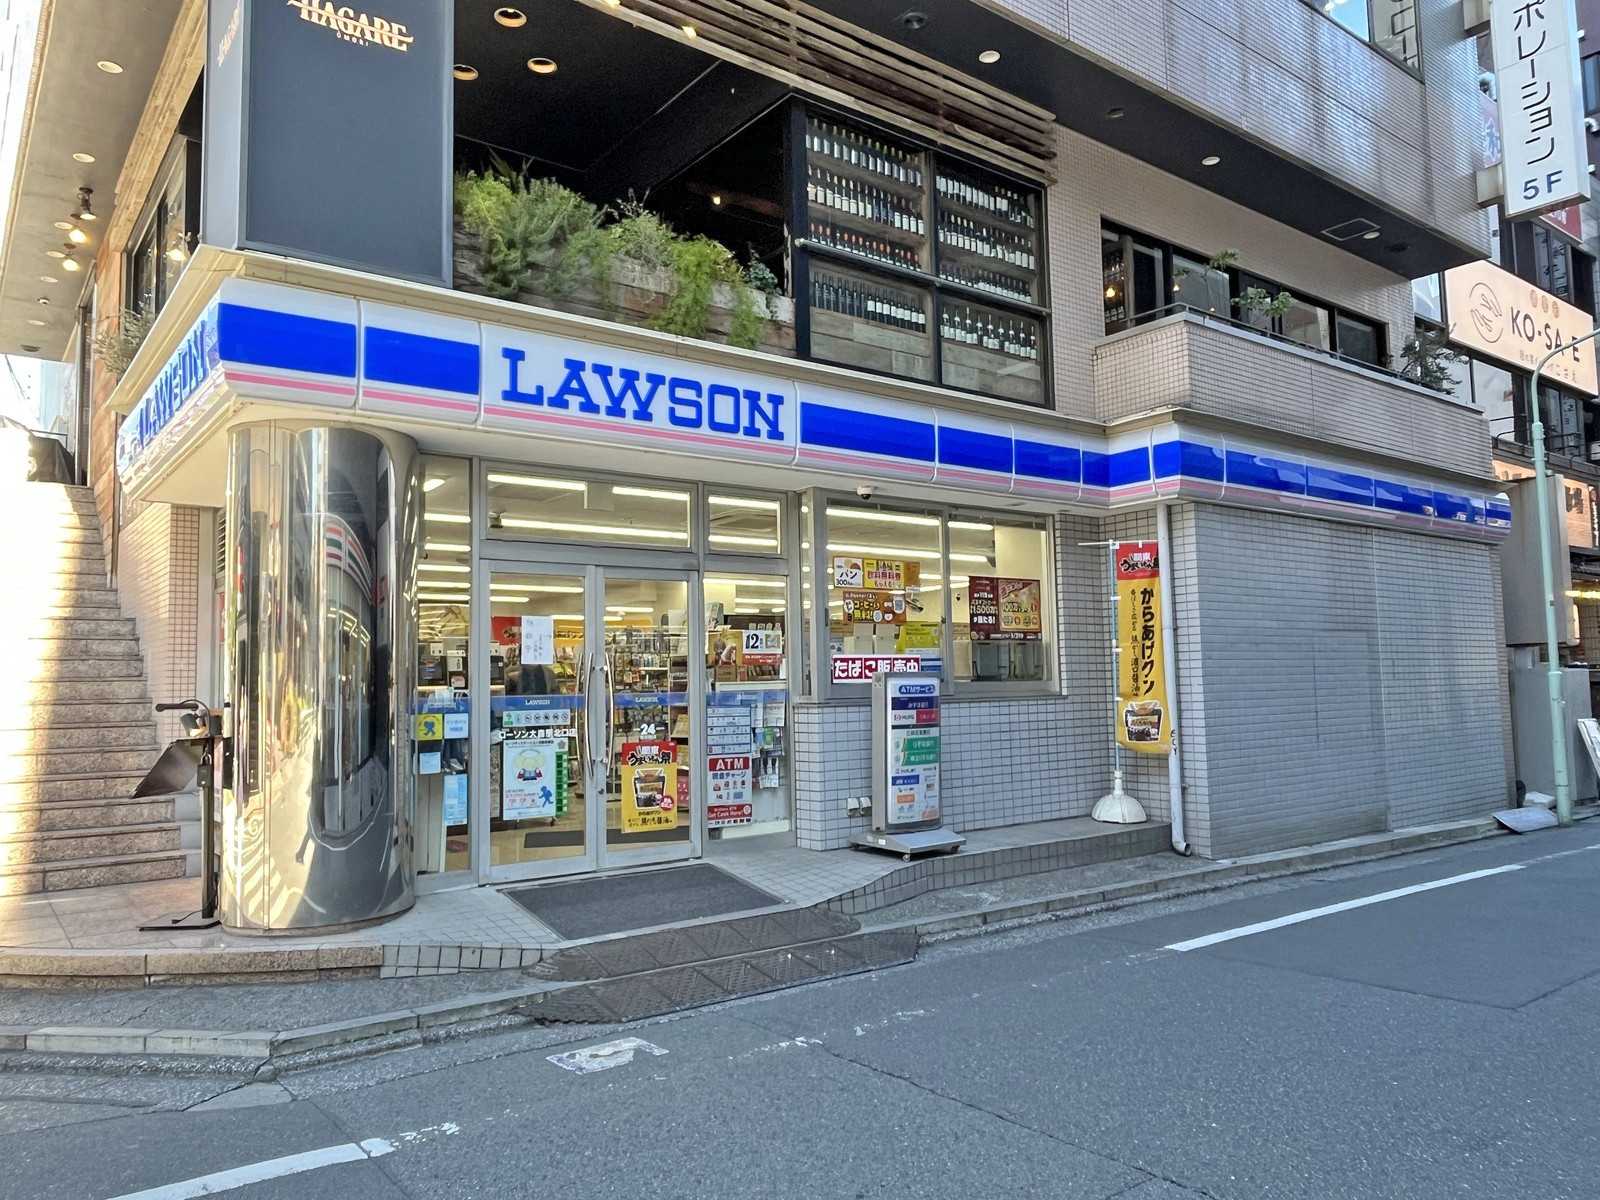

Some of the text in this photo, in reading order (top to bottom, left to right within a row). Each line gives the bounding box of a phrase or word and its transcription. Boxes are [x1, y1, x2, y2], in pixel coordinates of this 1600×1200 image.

[1523, 170, 1563, 201] 5F
[501, 347, 785, 441] LAWSON
[1140, 588, 1155, 696] からあげクン
[715, 758, 744, 771] ATM
